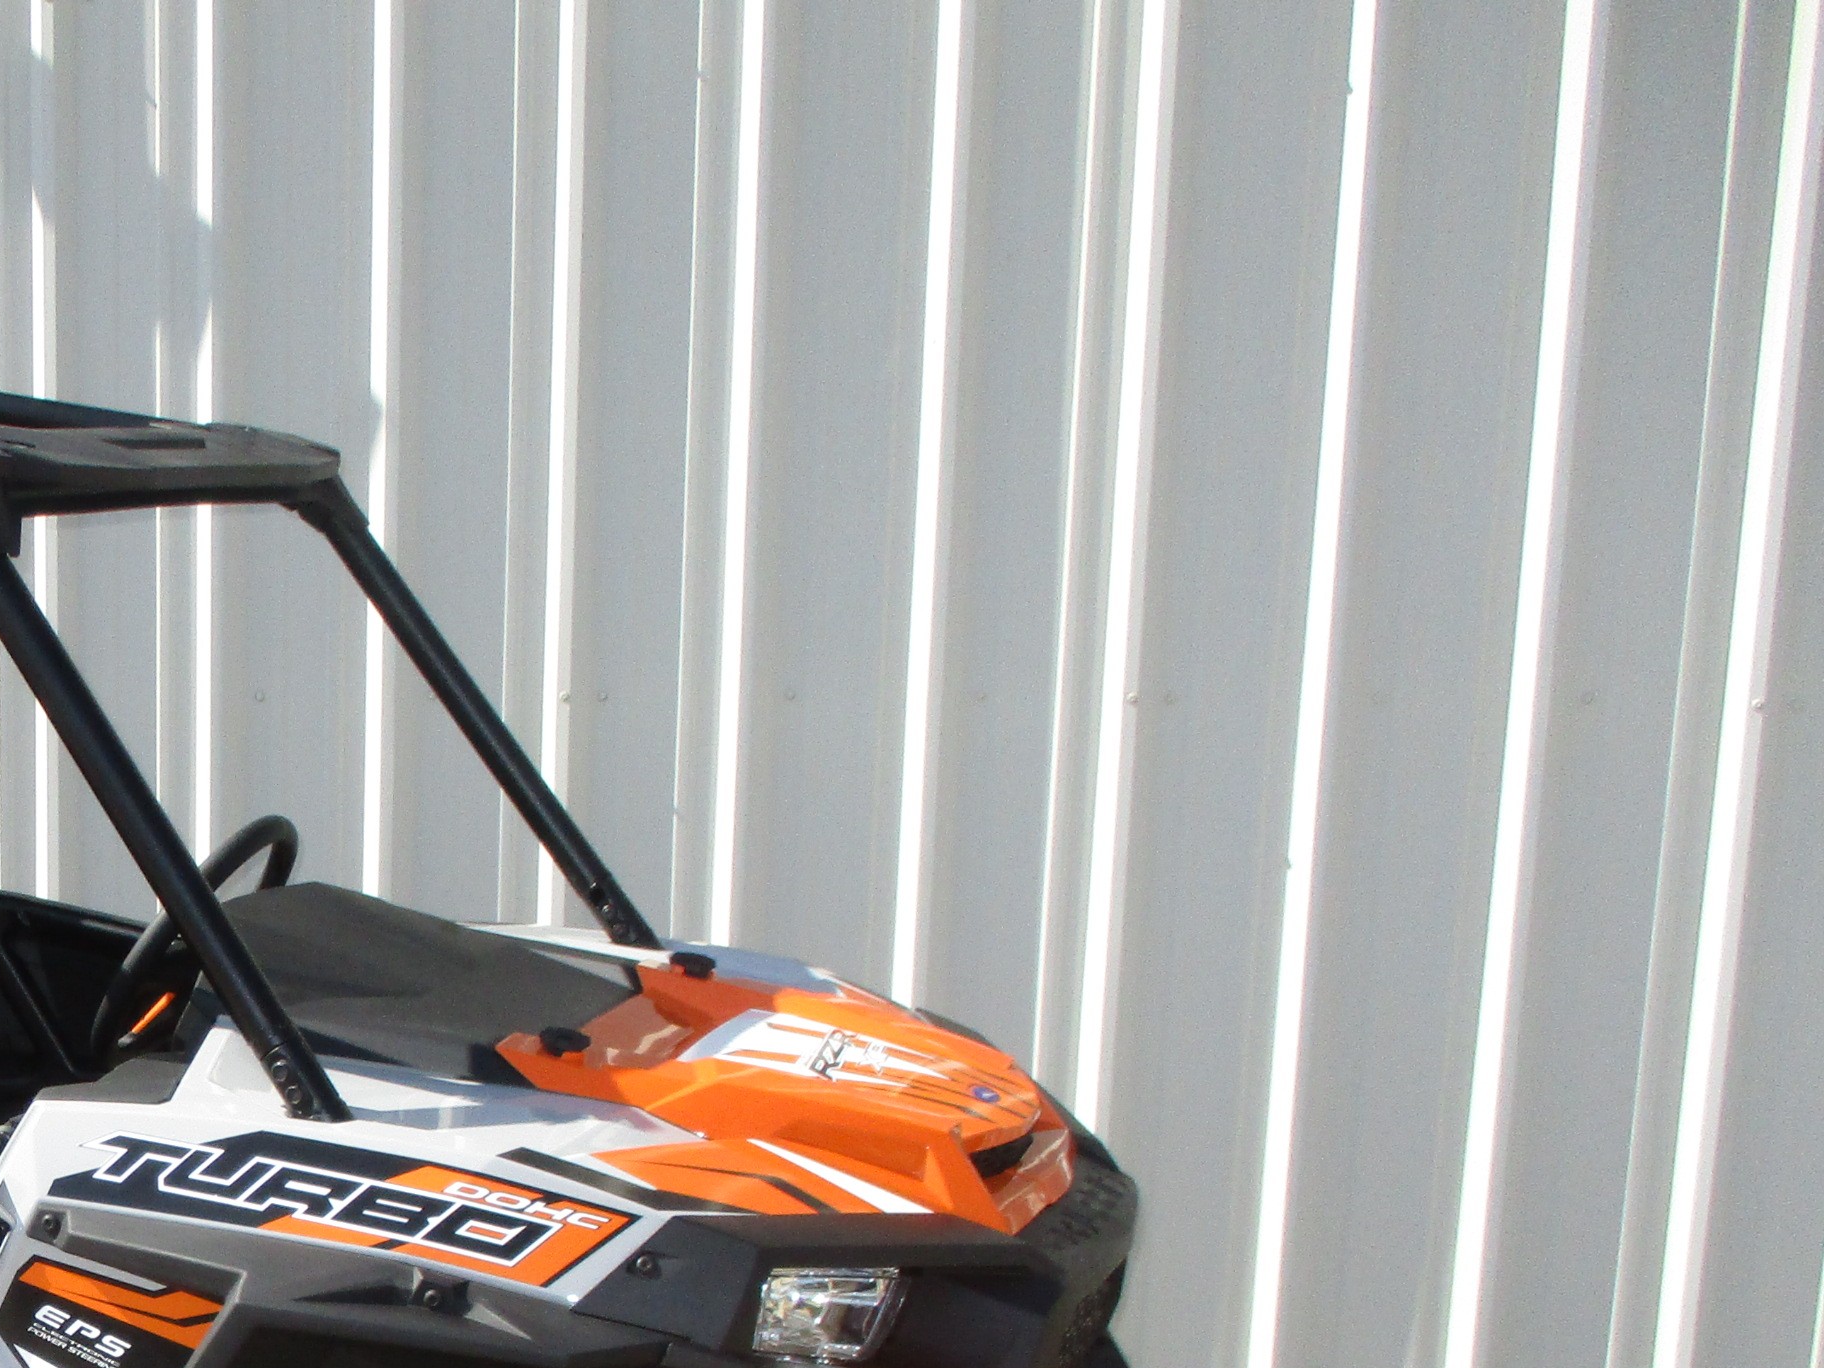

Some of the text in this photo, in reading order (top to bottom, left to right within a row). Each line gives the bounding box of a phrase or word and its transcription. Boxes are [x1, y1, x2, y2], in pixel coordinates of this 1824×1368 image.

[808, 1029, 858, 1081] RZR
[78, 1134, 564, 1267] TURBO
[442, 1181, 614, 1231] DOHC
[27, 1326, 68, 1349] POWER
[33, 1322, 121, 1367] ELECTRONIC
[34, 1305, 132, 1358] EPS
